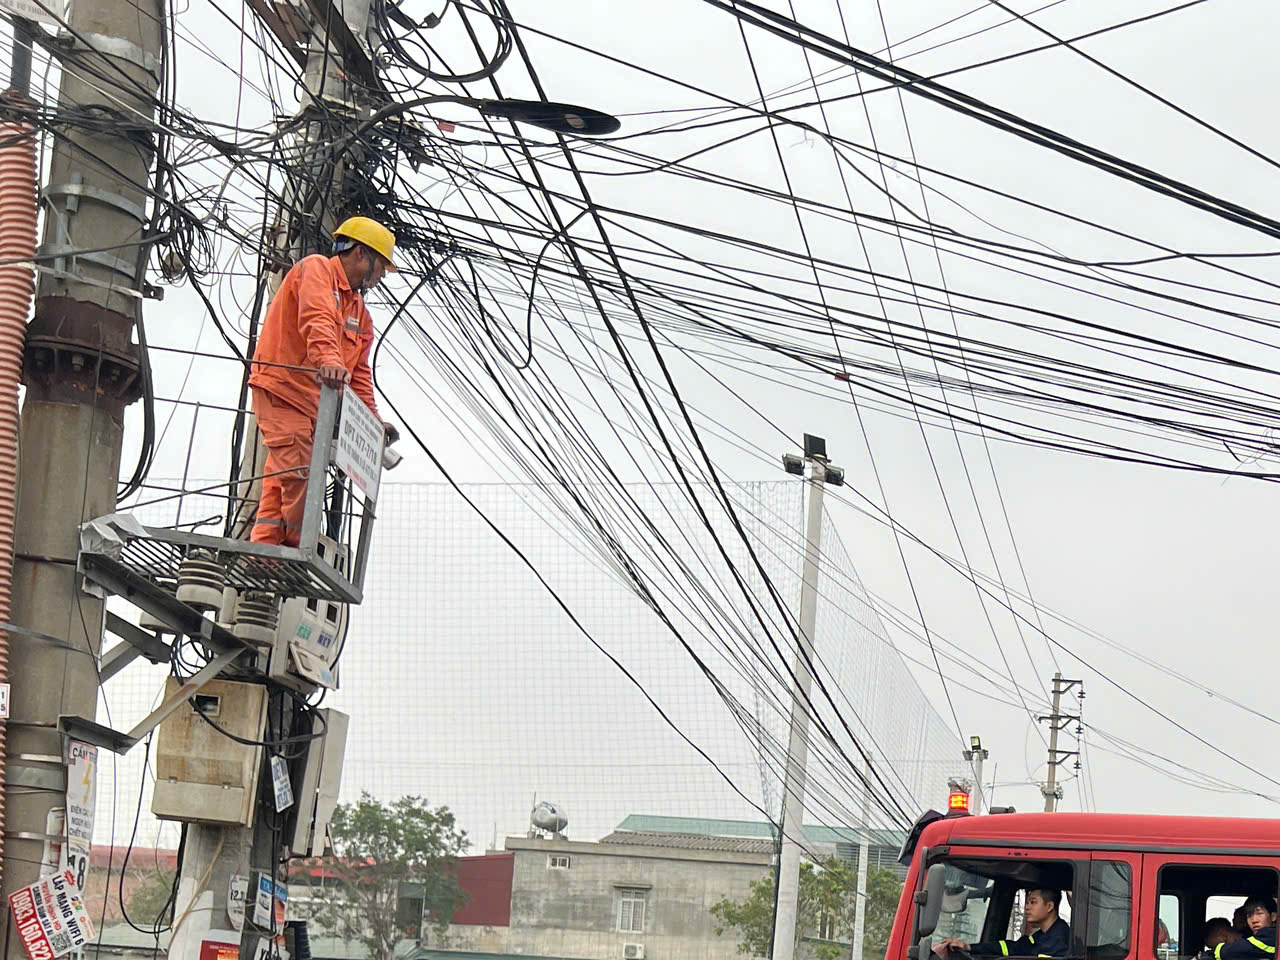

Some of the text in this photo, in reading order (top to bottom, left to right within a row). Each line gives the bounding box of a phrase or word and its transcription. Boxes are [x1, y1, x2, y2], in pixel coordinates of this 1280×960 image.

[56, 893, 73, 920] MẠNG
[66, 917, 82, 940] WIFI
[74, 938, 85, 946] 6
